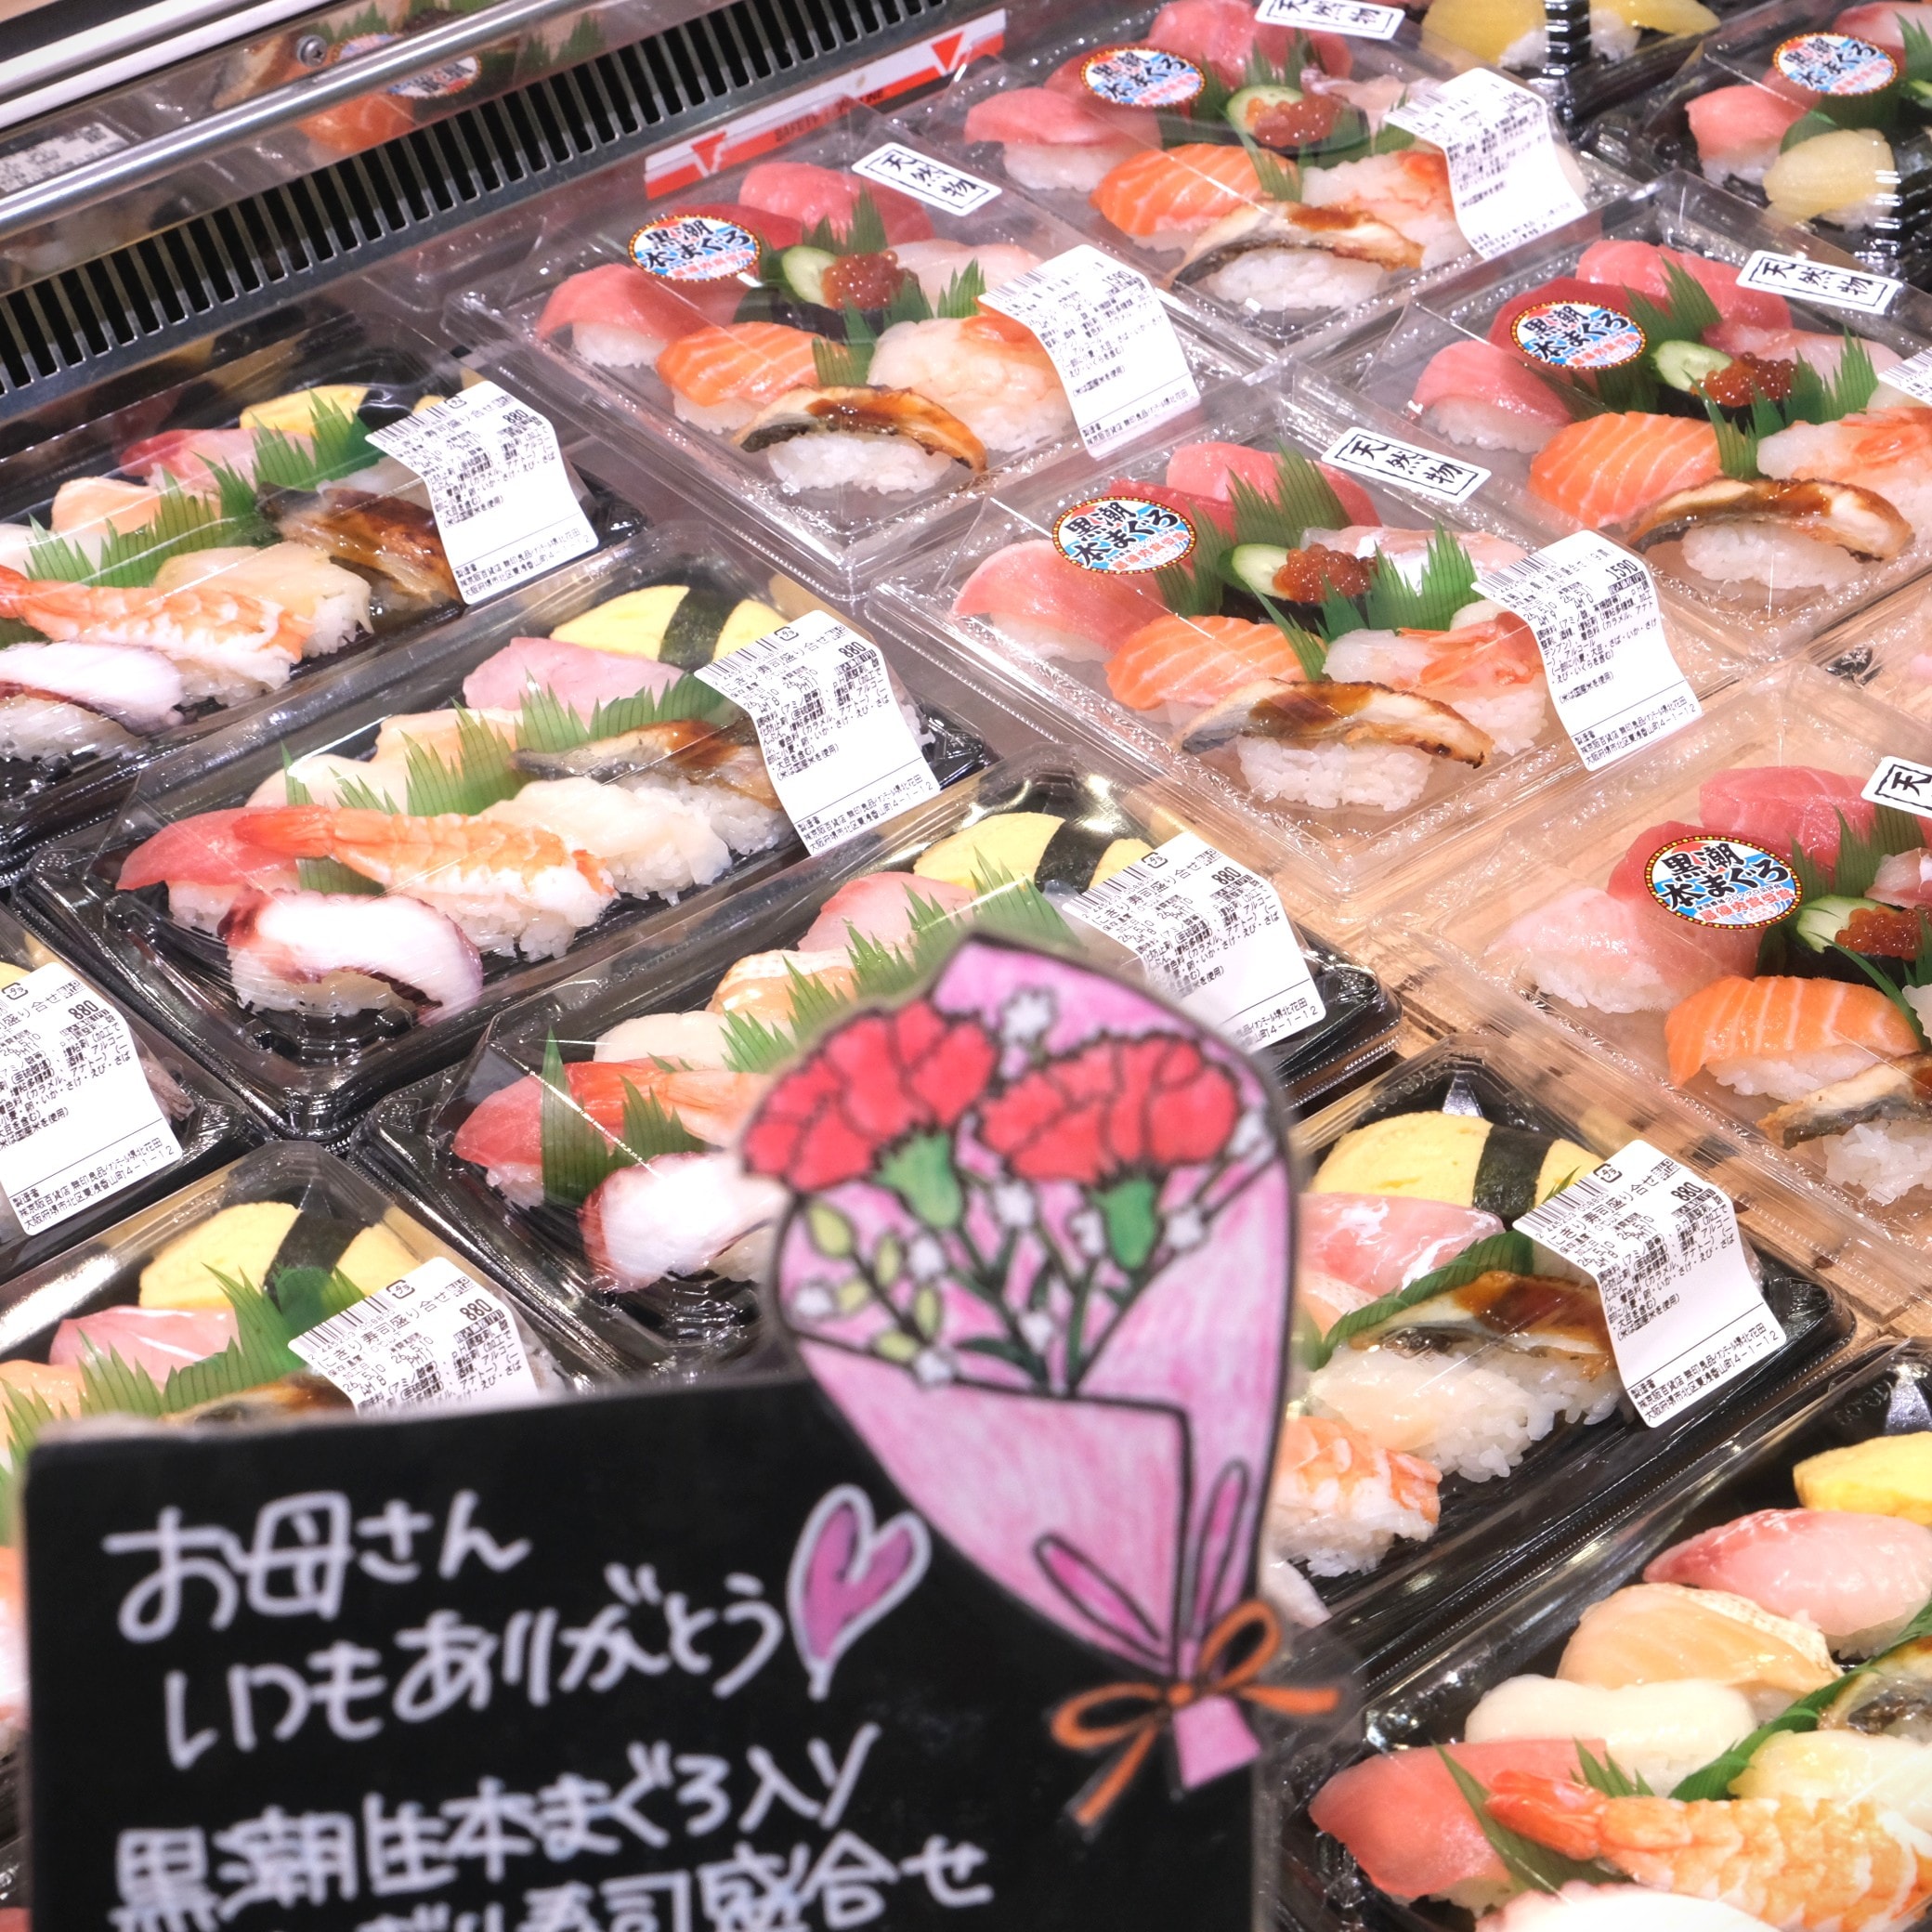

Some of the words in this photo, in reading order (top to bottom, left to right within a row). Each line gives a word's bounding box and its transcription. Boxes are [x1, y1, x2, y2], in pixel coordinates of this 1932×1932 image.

[881, 154, 977, 198] 天然物
[646, 219, 713, 248] 黒潮
[646, 229, 751, 268] 本まぐろ
[1761, 262, 1873, 296] 天然物
[1523, 306, 1589, 339] 黒潮
[1533, 313, 1628, 359] 本まぐろ
[502, 409, 529, 424] 880
[1350, 438, 1468, 486] 天然物
[1064, 502, 1137, 542] 黒潮
[1073, 509, 1179, 567] 本まぐろ
[1605, 559, 1638, 581] 1590
[838, 641, 867, 659] 880
[1210, 866, 1242, 885] 880
[1661, 842, 1744, 881] 黒潮
[1660, 859, 1789, 909] 本まぐろ
[68, 1000, 99, 1020] 880
[1547, 1174, 1659, 1247] にぎり寿司盛り合せ
[1671, 1181, 1703, 1201] 880
[460, 1298, 492, 1321] 880
[318, 1290, 450, 1370] にぎり寿司盛り合せ
[102, 1490, 530, 1642] お母さん
[163, 1561, 783, 1768] いつもありがとう
[109, 1723, 881, 1932] 黒潮生本まぐろ入り
